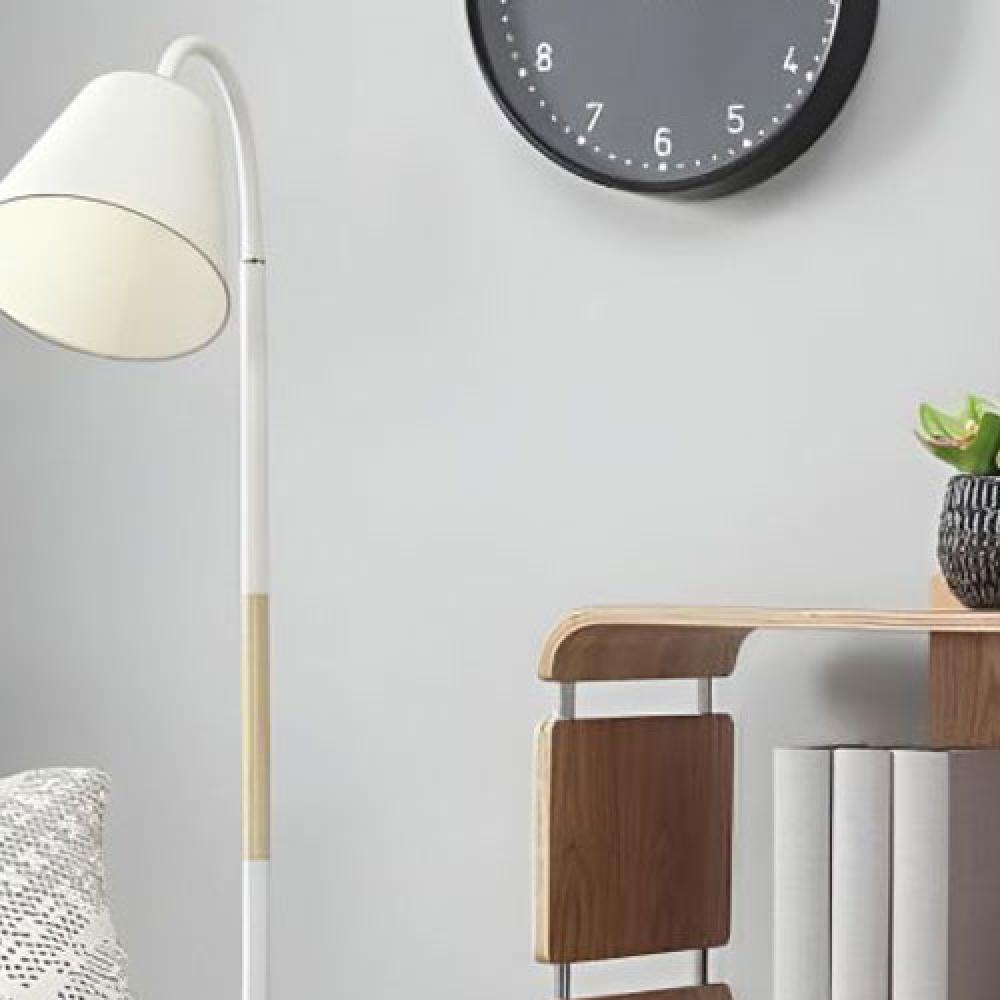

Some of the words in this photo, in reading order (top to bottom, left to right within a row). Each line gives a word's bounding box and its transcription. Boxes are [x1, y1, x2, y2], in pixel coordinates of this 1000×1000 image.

[536, 42, 552, 72] 8
[784, 46, 798, 74] 4
[586, 102, 604, 132] 7
[728, 104, 744, 134] 5
[654, 128, 672, 156] 6
